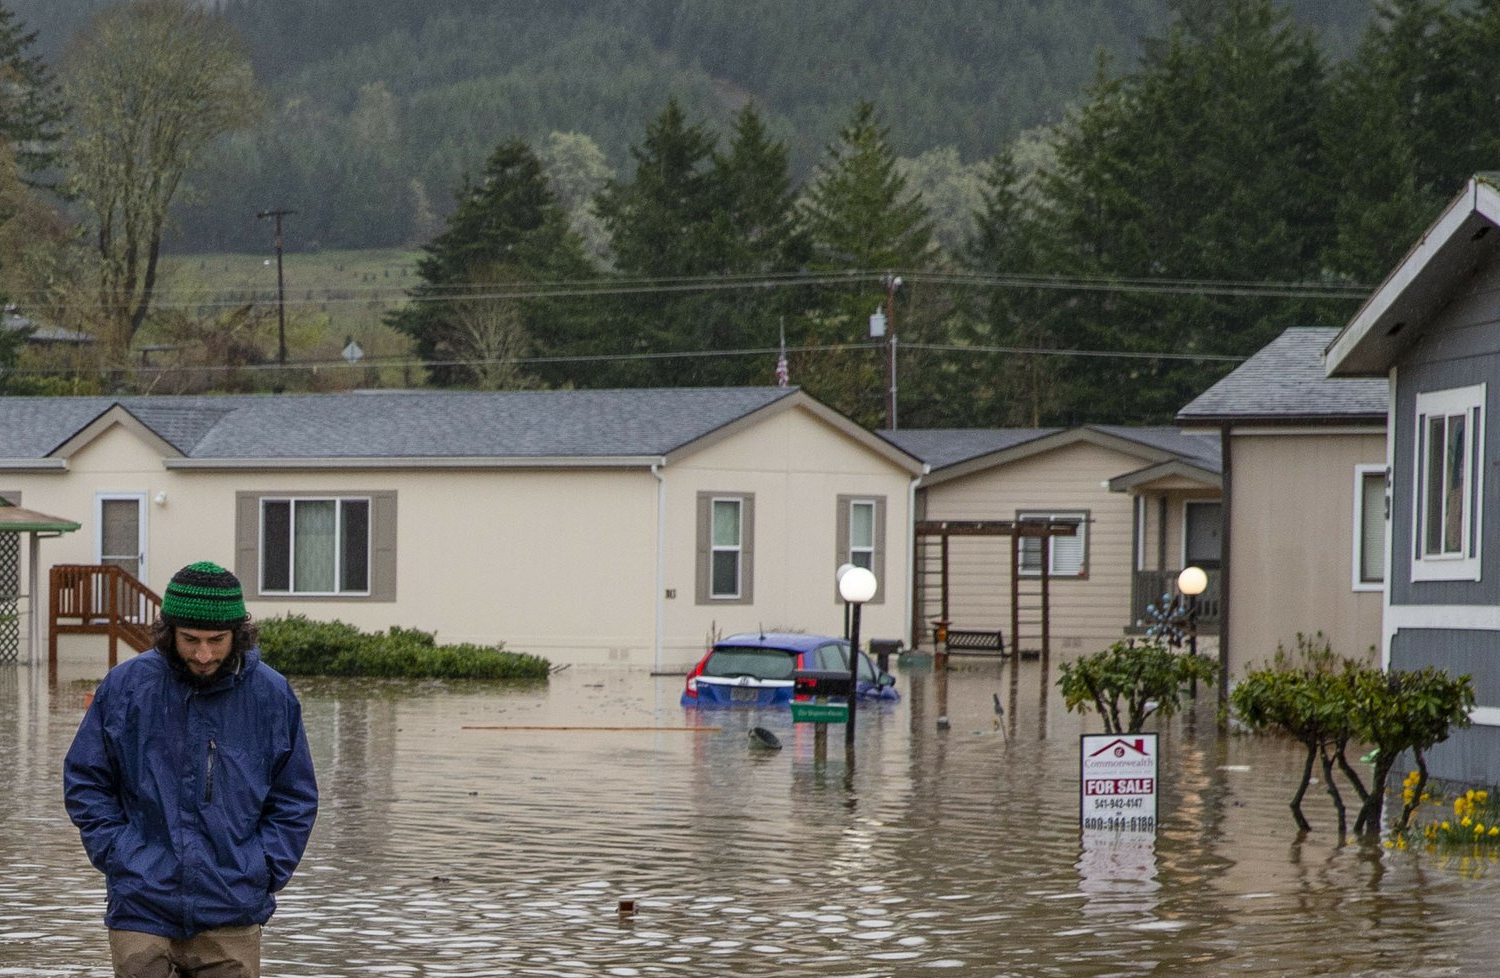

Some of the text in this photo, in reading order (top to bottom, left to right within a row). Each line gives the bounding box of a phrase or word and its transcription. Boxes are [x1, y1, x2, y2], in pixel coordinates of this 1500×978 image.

[1085, 758, 1153, 768] Commonwealth
[1087, 780, 1151, 794] FOR SALE
